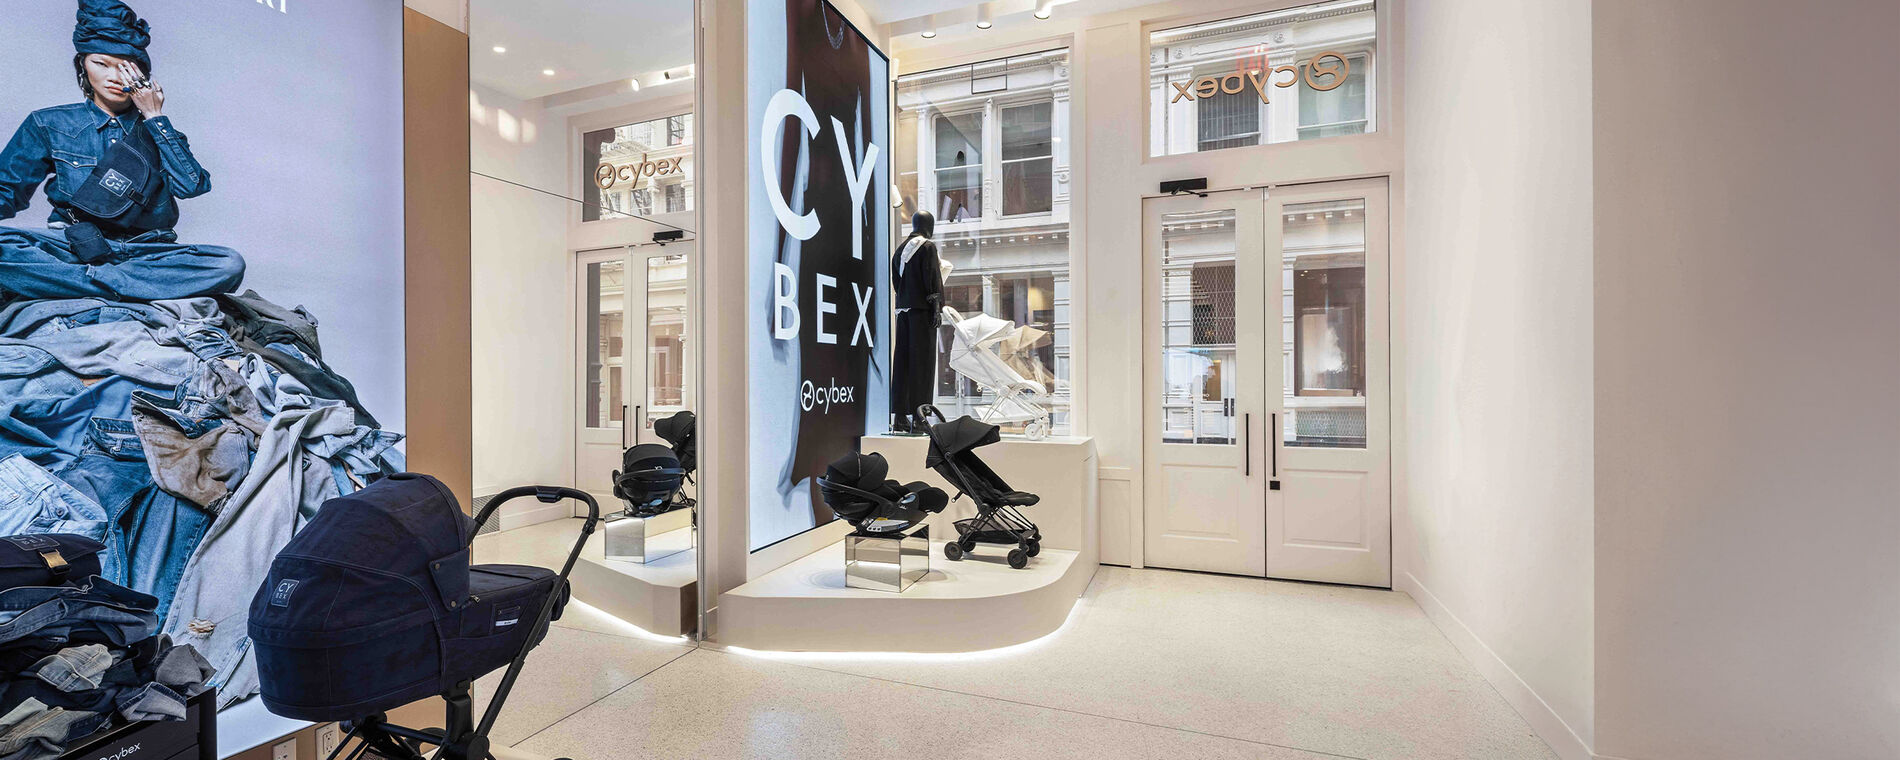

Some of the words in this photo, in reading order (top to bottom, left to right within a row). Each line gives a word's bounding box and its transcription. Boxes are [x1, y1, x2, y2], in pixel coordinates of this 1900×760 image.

[105, 173, 119, 187] CY
[617, 153, 682, 189] cybex
[761, 88, 880, 260] CY
[774, 261, 875, 349] BEX
[816, 377, 854, 415] cybex
[278, 582, 295, 593] CY
